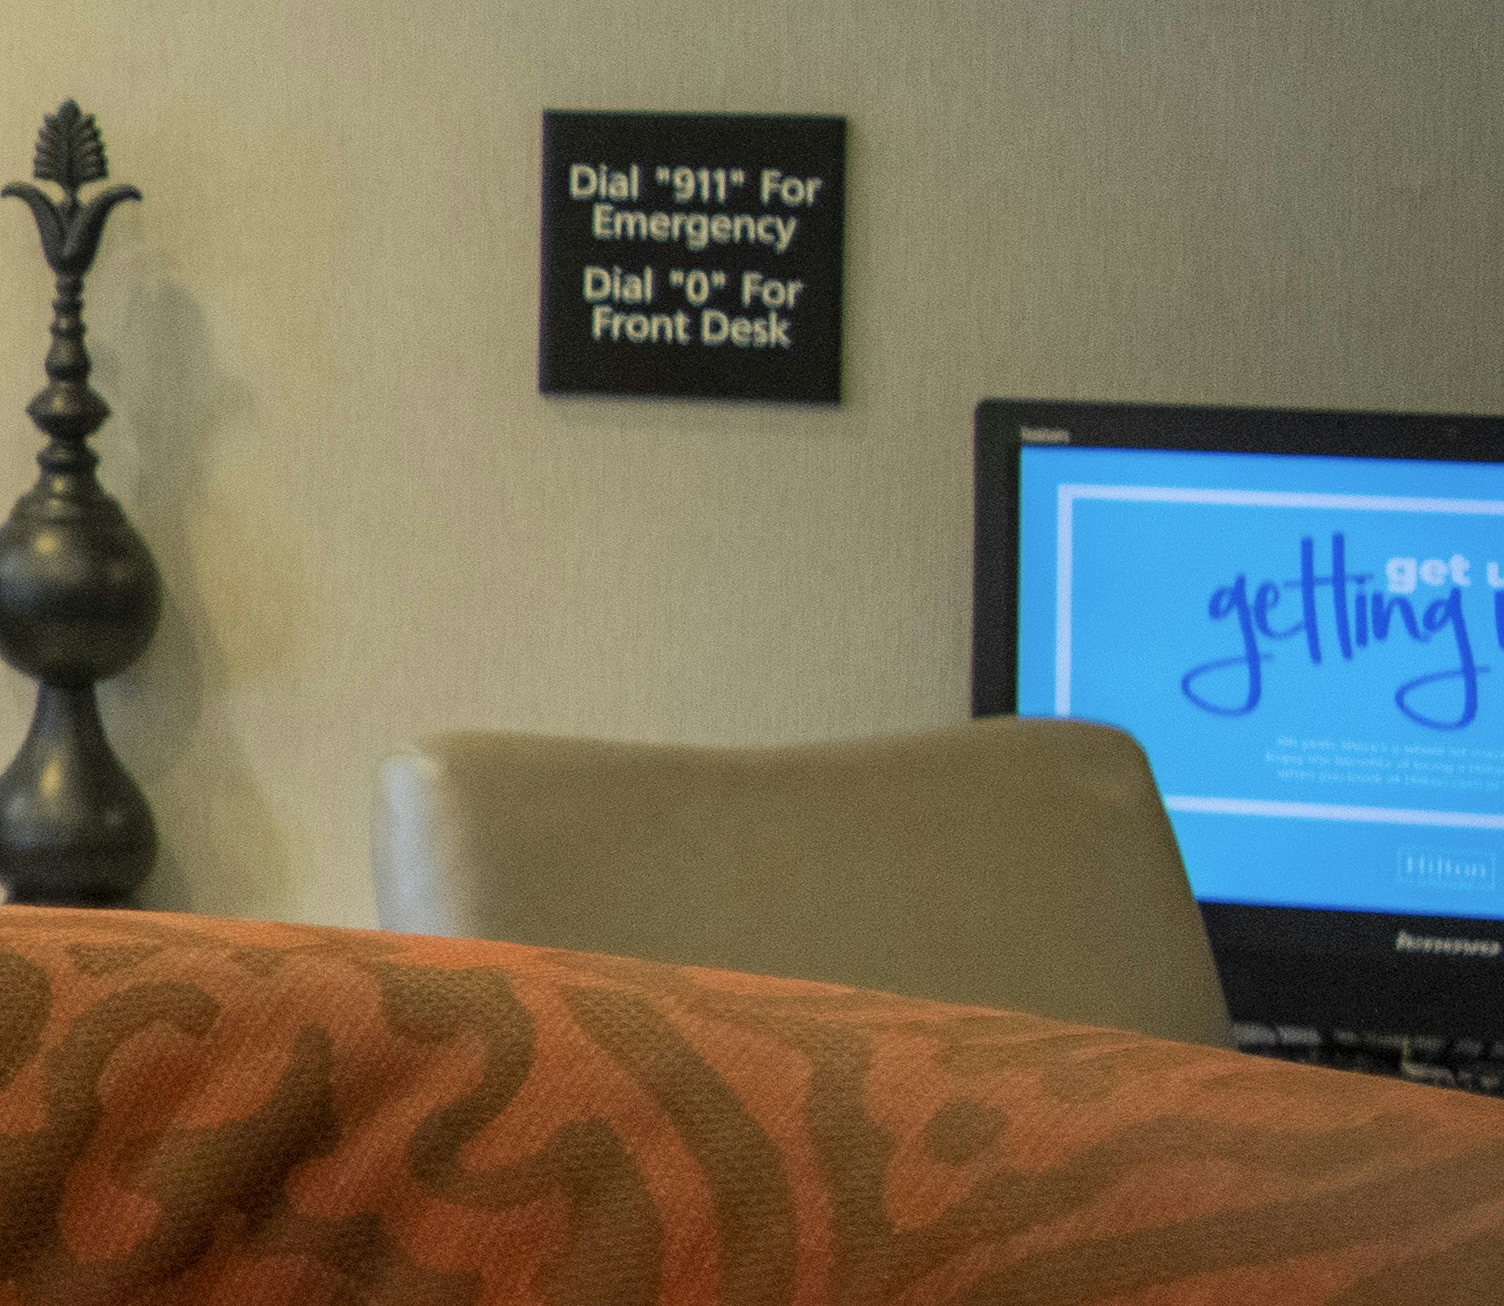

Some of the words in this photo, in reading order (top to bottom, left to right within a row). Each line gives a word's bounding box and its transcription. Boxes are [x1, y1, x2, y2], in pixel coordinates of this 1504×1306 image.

[570, 163, 639, 202] Dial
[655, 167, 745, 203] "911"
[760, 169, 822, 205] For
[592, 202, 798, 254] Emergency
[584, 265, 653, 304] Dial
[670, 268, 727, 306] "0"
[742, 270, 803, 308] For
[592, 304, 690, 344] Front
[701, 309, 791, 348] Desk
[1385, 554, 1472, 594] get
[1181, 530, 1492, 732] getting
